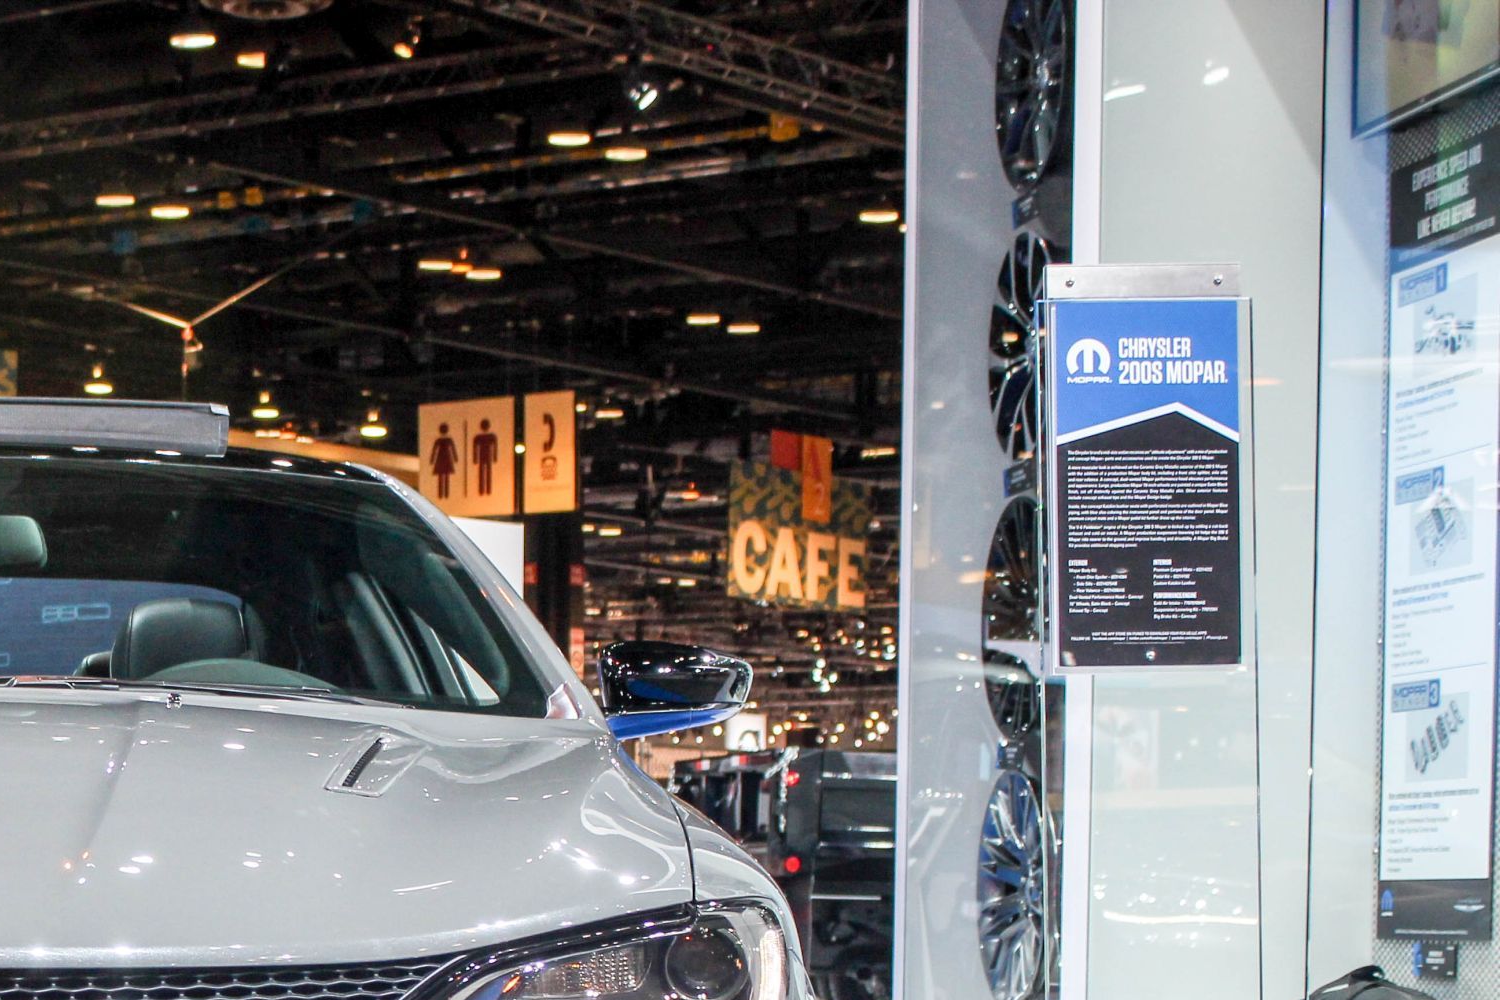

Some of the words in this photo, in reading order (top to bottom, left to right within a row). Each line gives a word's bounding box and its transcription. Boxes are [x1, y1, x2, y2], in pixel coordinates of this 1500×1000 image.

[1118, 337, 1191, 359] CHRYSLER
[1118, 360, 1163, 385] 200S
[733, 519, 866, 608] CAFE
